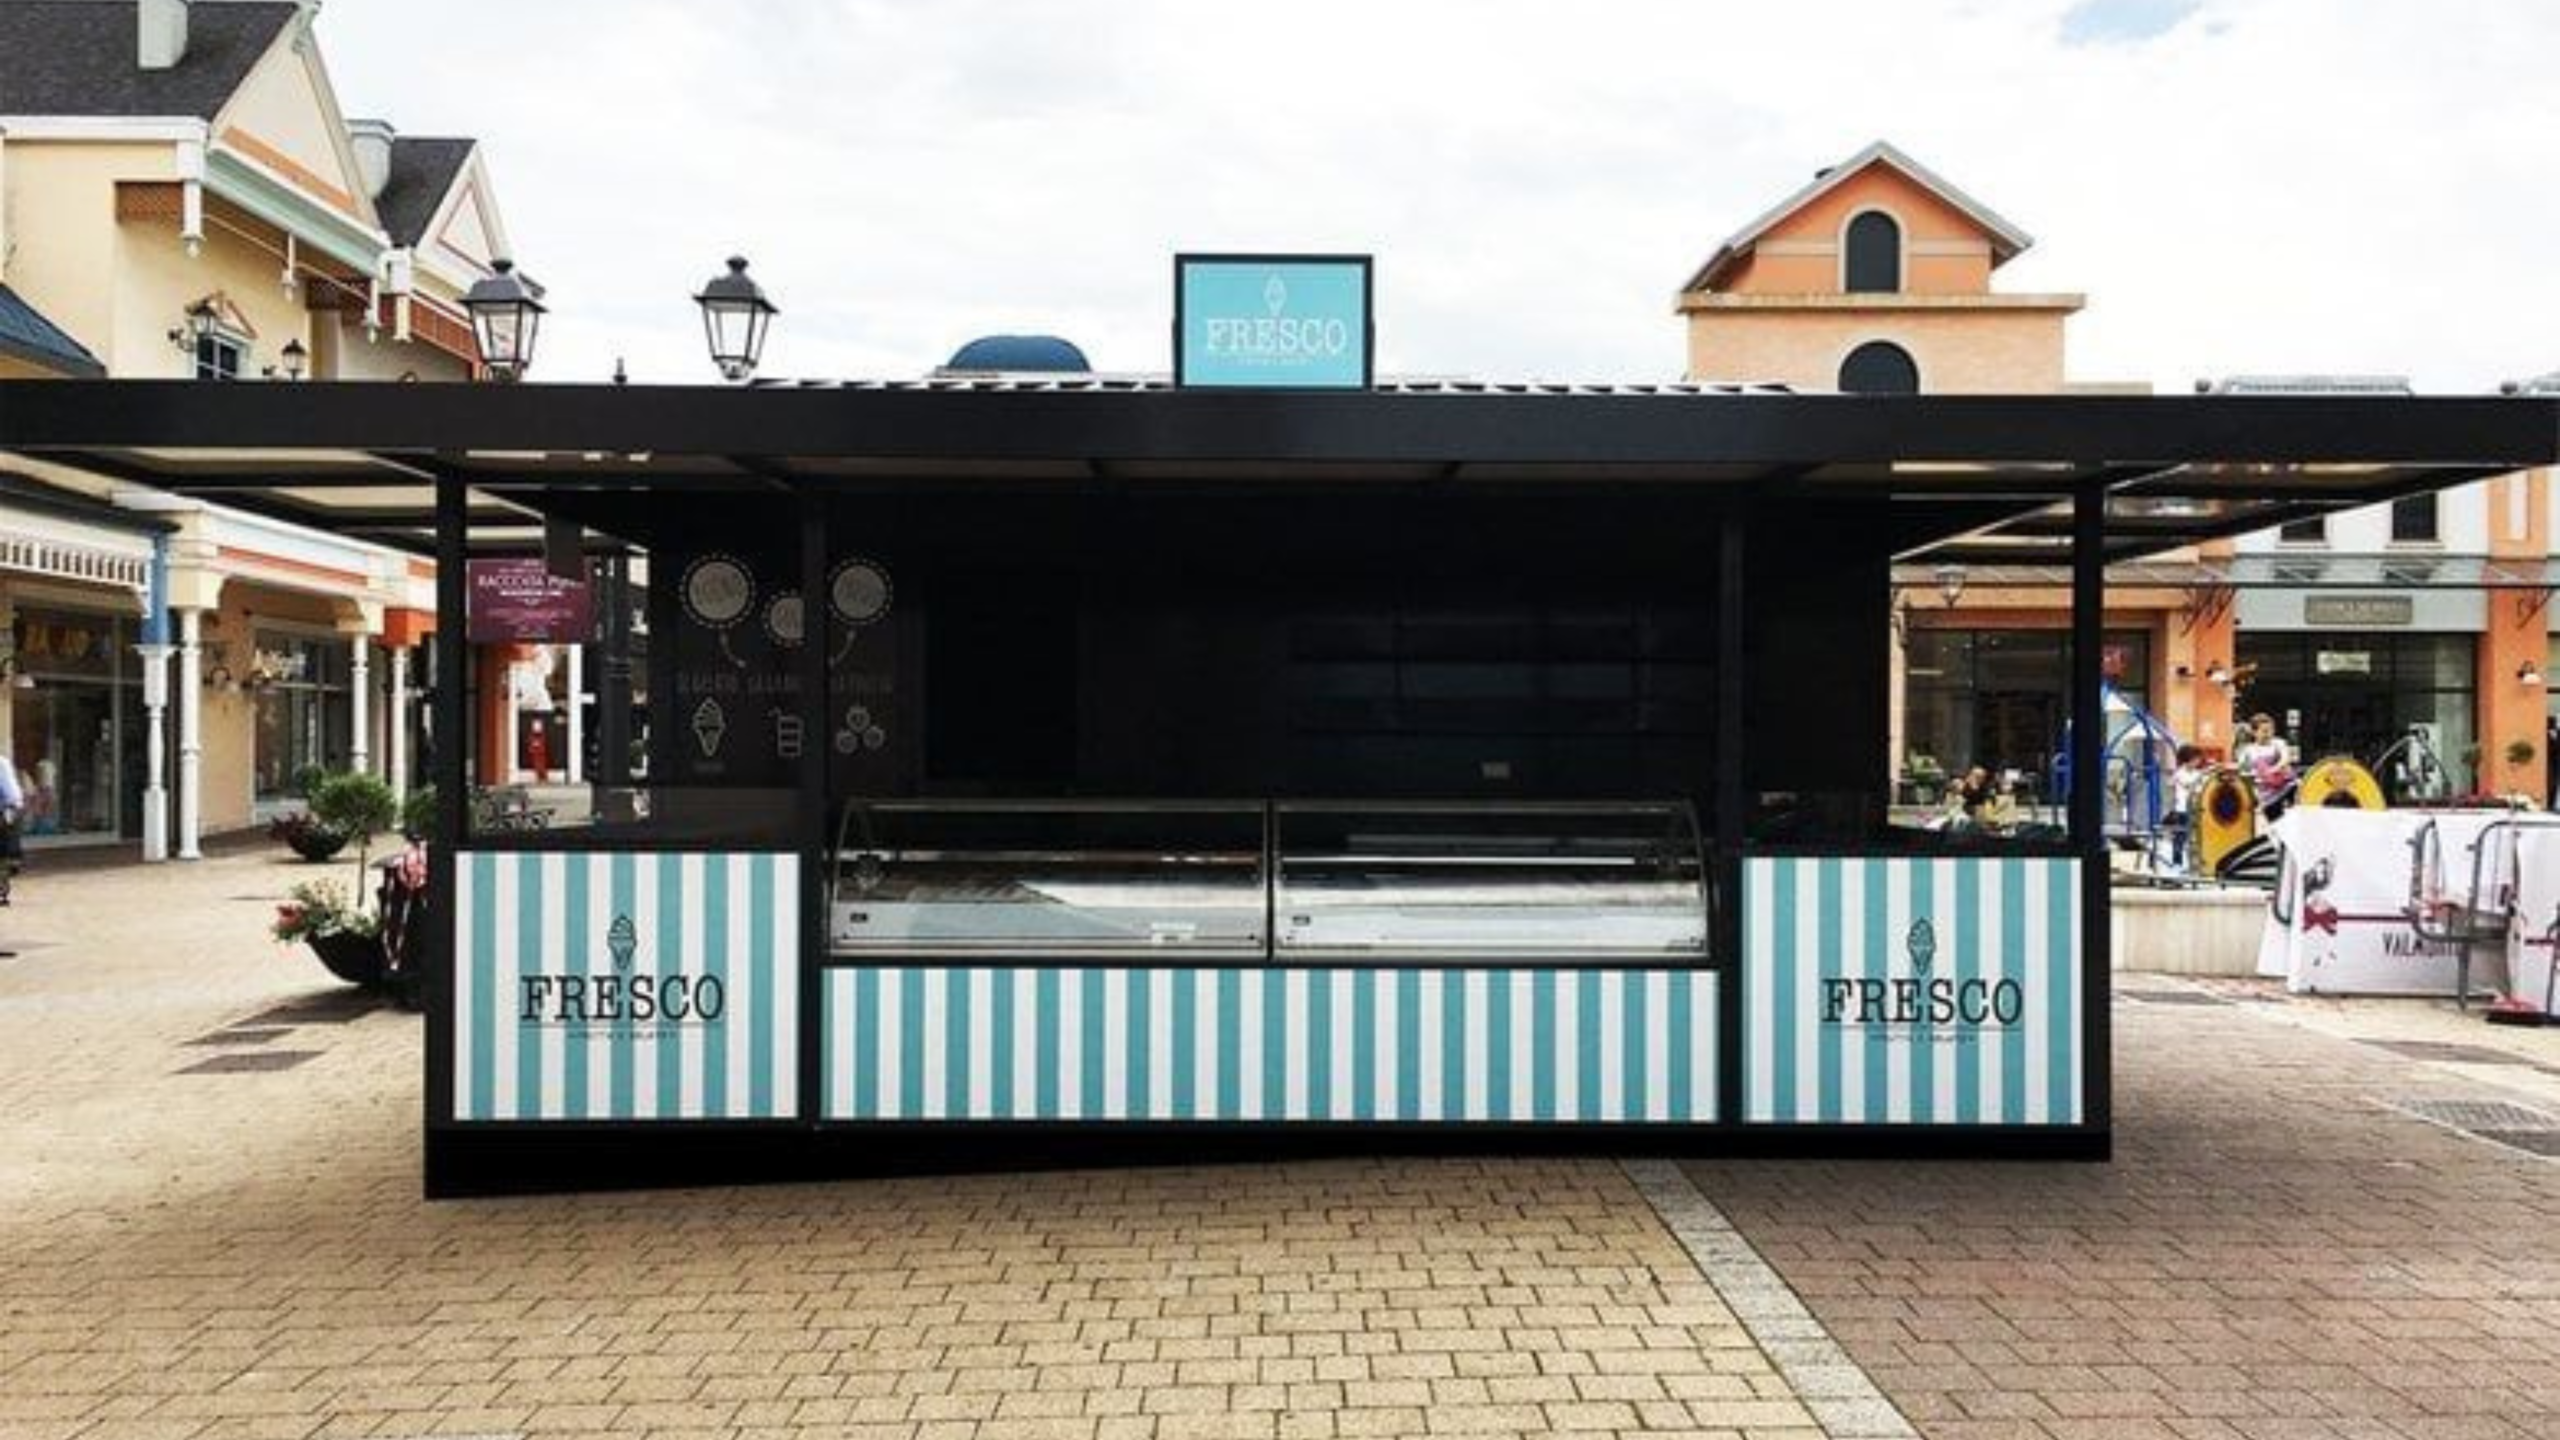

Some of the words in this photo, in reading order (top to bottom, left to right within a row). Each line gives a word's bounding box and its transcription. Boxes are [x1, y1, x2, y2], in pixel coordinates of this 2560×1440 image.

[1205, 318, 1347, 355] FRESCO
[520, 974, 724, 1021] FRESCO
[1820, 978, 2023, 1025] FRESCO
